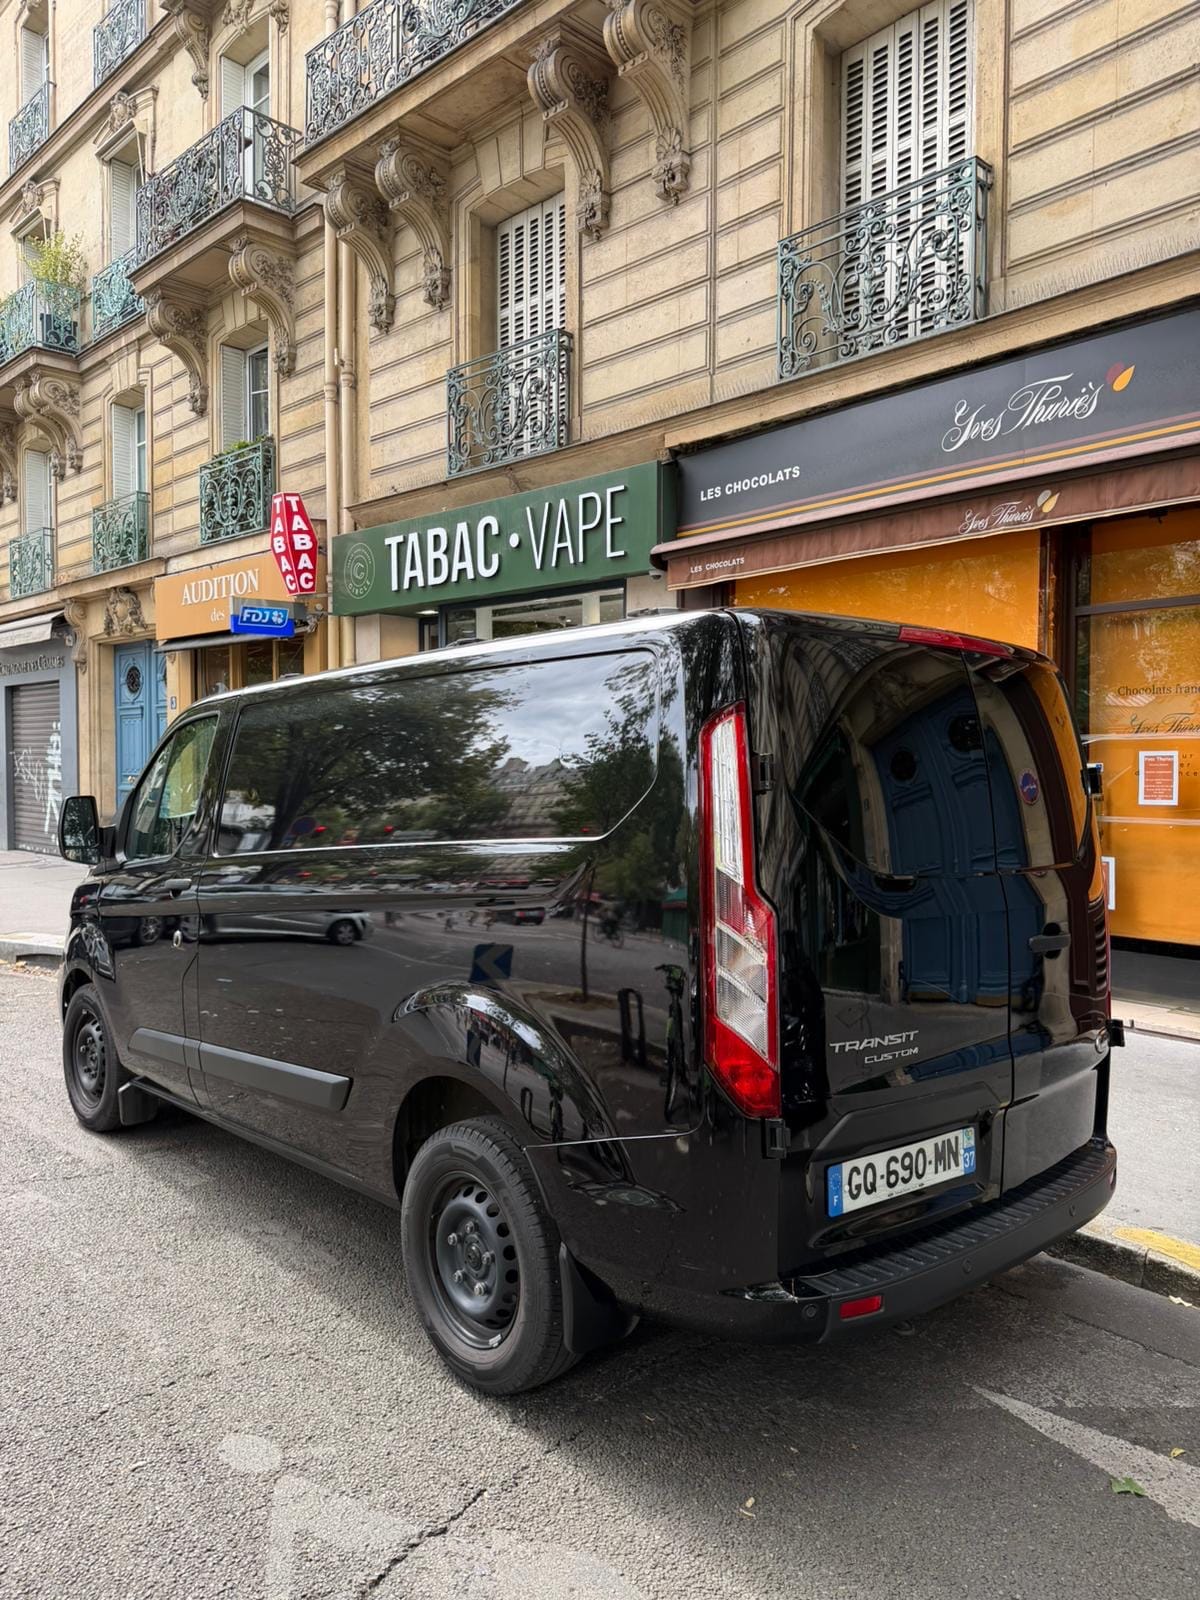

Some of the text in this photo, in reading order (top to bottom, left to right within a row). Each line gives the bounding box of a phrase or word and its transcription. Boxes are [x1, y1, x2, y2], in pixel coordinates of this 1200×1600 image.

[941, 373, 1104, 452] Yves Thuriès
[700, 466, 801, 501] LES CHOCOLATS
[959, 509, 989, 534] Yves
[273, 497, 297, 591] TABAC
[286, 496, 314, 589] TABAC
[385, 485, 626, 592] TABAC VAPE
[690, 557, 745, 574] LES CHOCOLATS
[181, 568, 259, 606] AUDITION
[210, 608, 225, 623] des
[242, 608, 270, 624] FDJ
[1117, 684, 1172, 697] Chocolats
[829, 1030, 919, 1054] TRANSIT
[864, 1046, 919, 1064] CUSTOM
[847, 1135, 960, 1201] GQ-690-MN
[963, 1150, 975, 1168] 37
